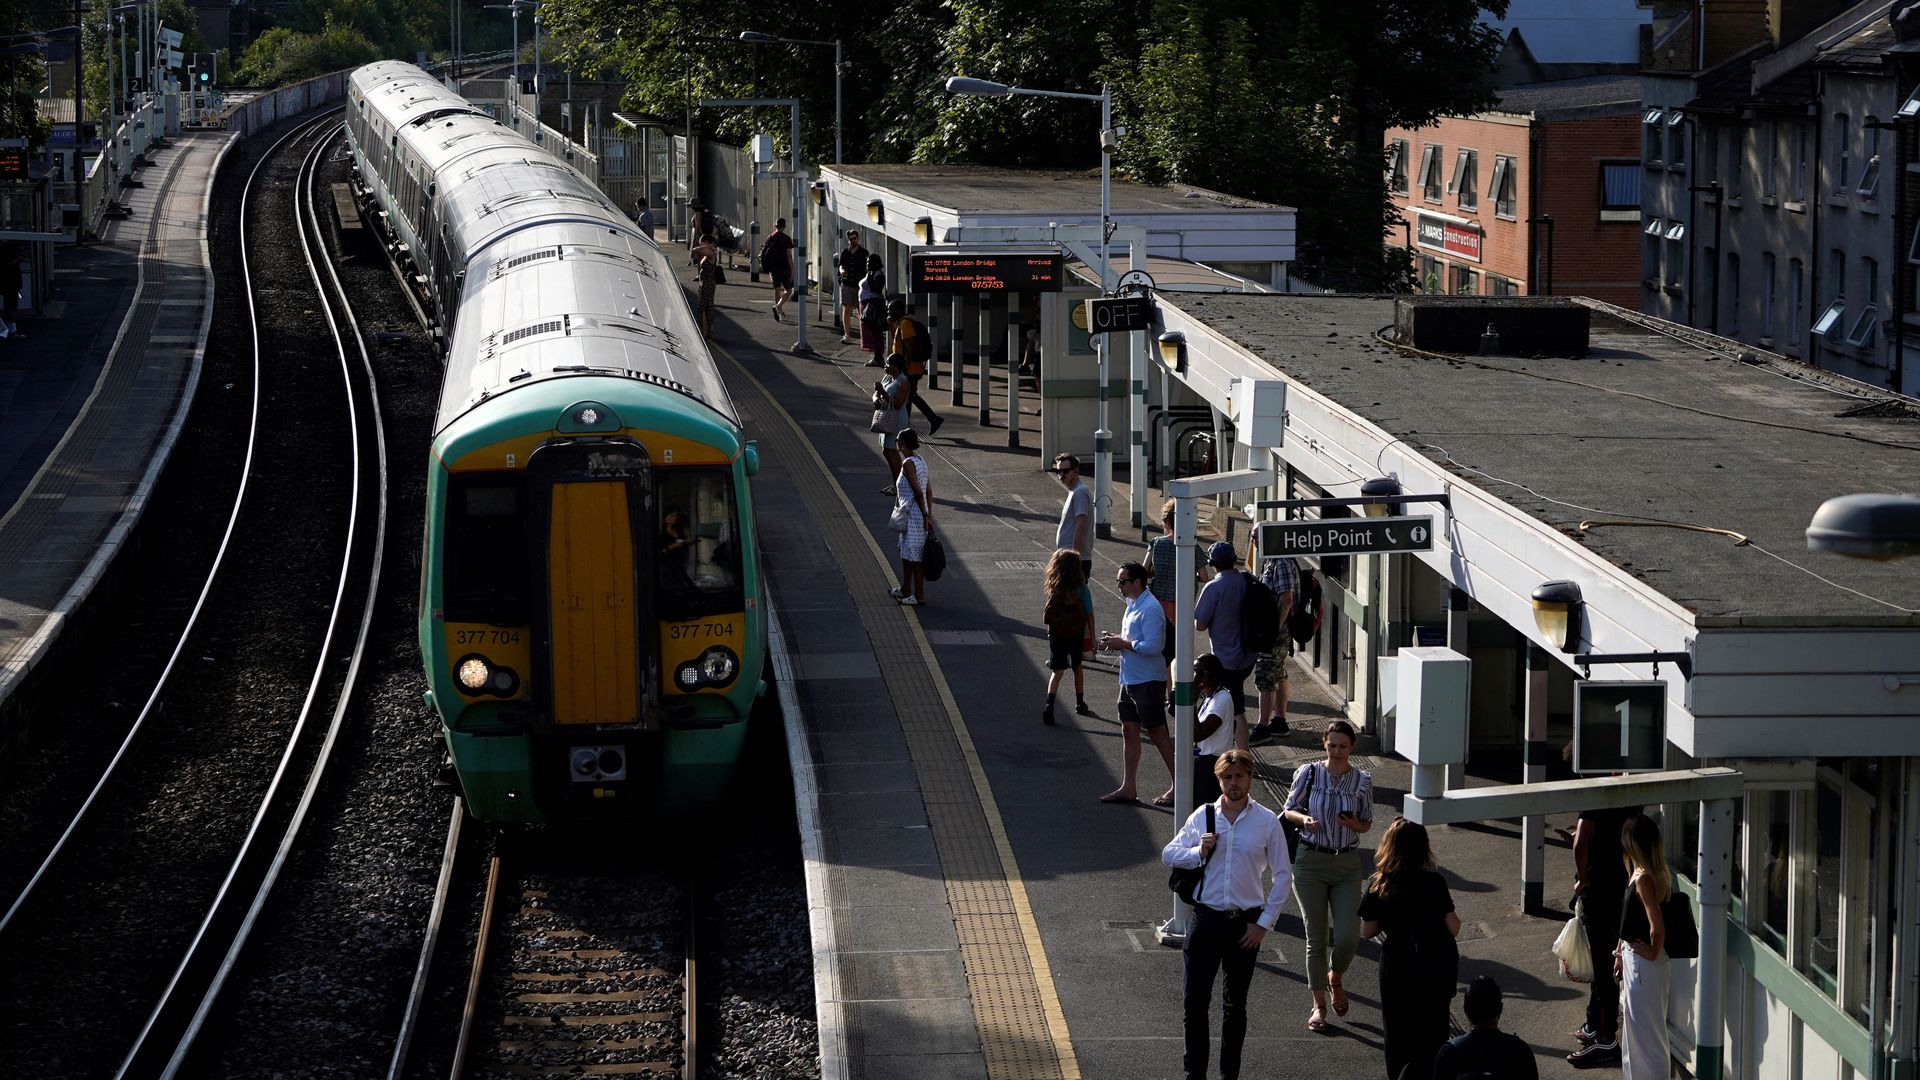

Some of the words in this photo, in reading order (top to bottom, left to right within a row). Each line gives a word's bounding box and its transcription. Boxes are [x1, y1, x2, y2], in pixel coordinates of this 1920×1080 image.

[131, 80, 139, 91] 2
[1096, 303, 1140, 328] OFF
[1284, 530, 1323, 551] Help
[1328, 529, 1373, 547] Point
[456, 630, 487, 645] 377
[490, 630, 521, 645] 704
[670, 624, 701, 640] 377
[703, 622, 734, 638] 704
[1614, 699, 1630, 758] 1
